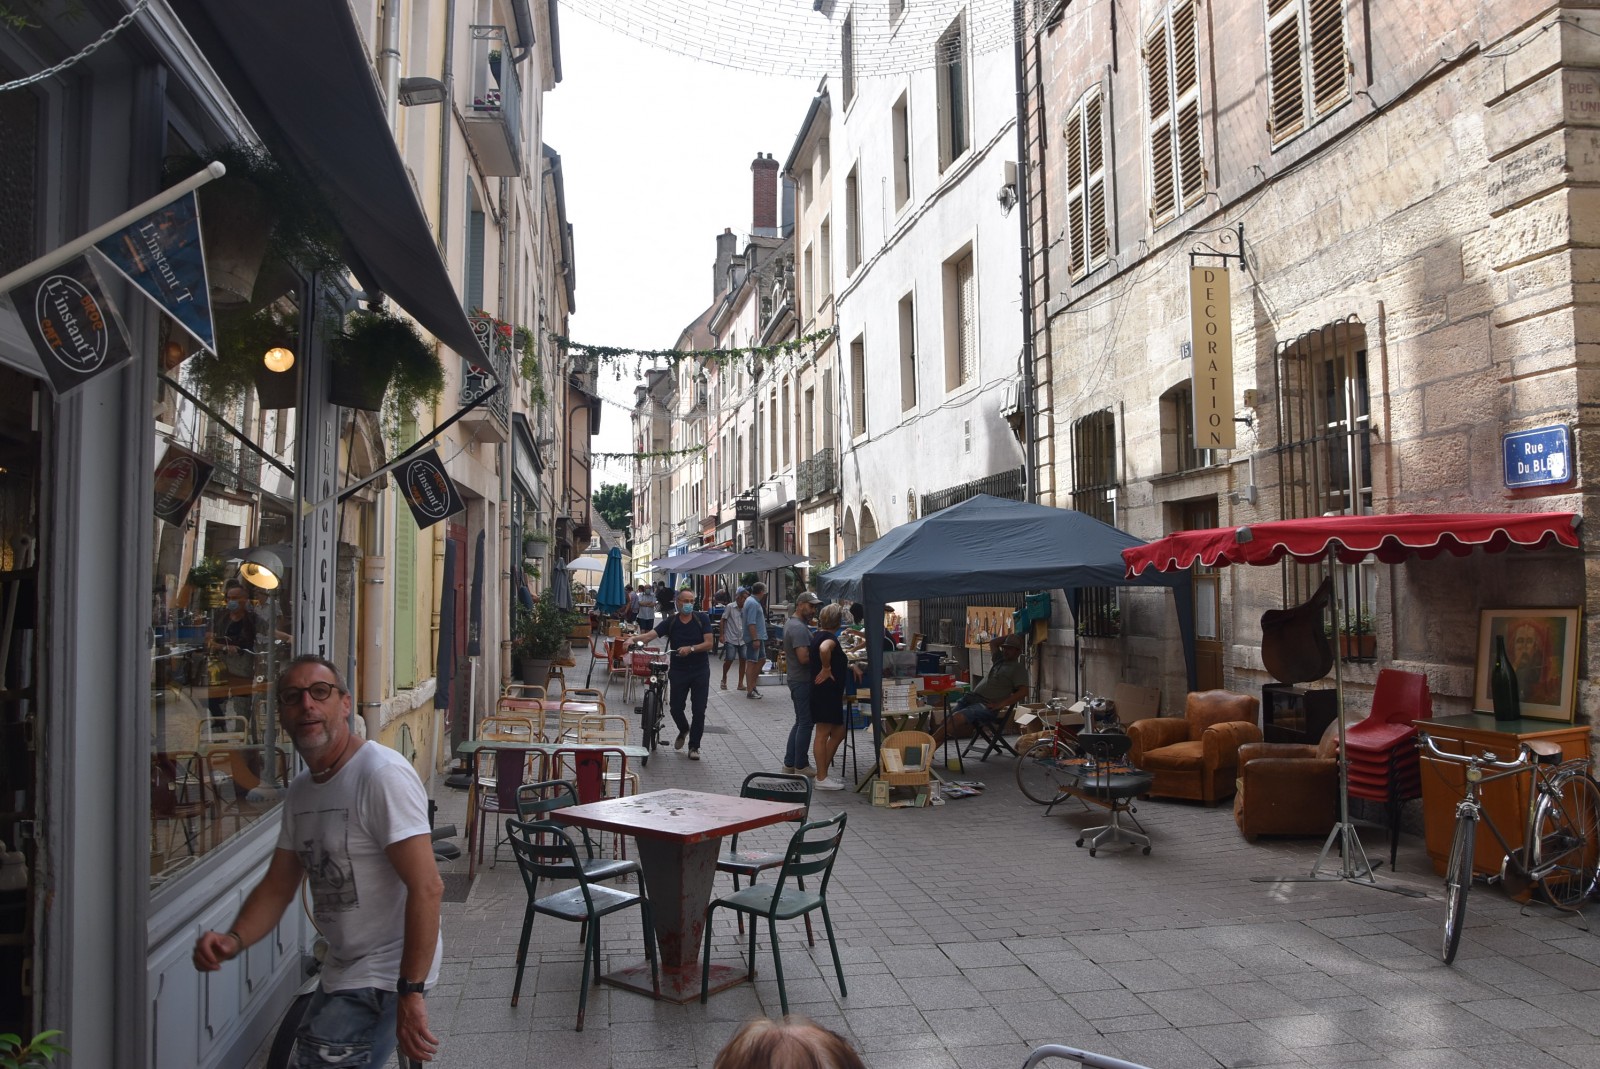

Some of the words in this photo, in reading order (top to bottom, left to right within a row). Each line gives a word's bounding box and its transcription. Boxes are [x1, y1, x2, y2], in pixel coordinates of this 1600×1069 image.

[1568, 83, 1593, 94] RUE
[1203, 270, 1221, 445] DECORATION
[1524, 442, 1544, 455] Rue
